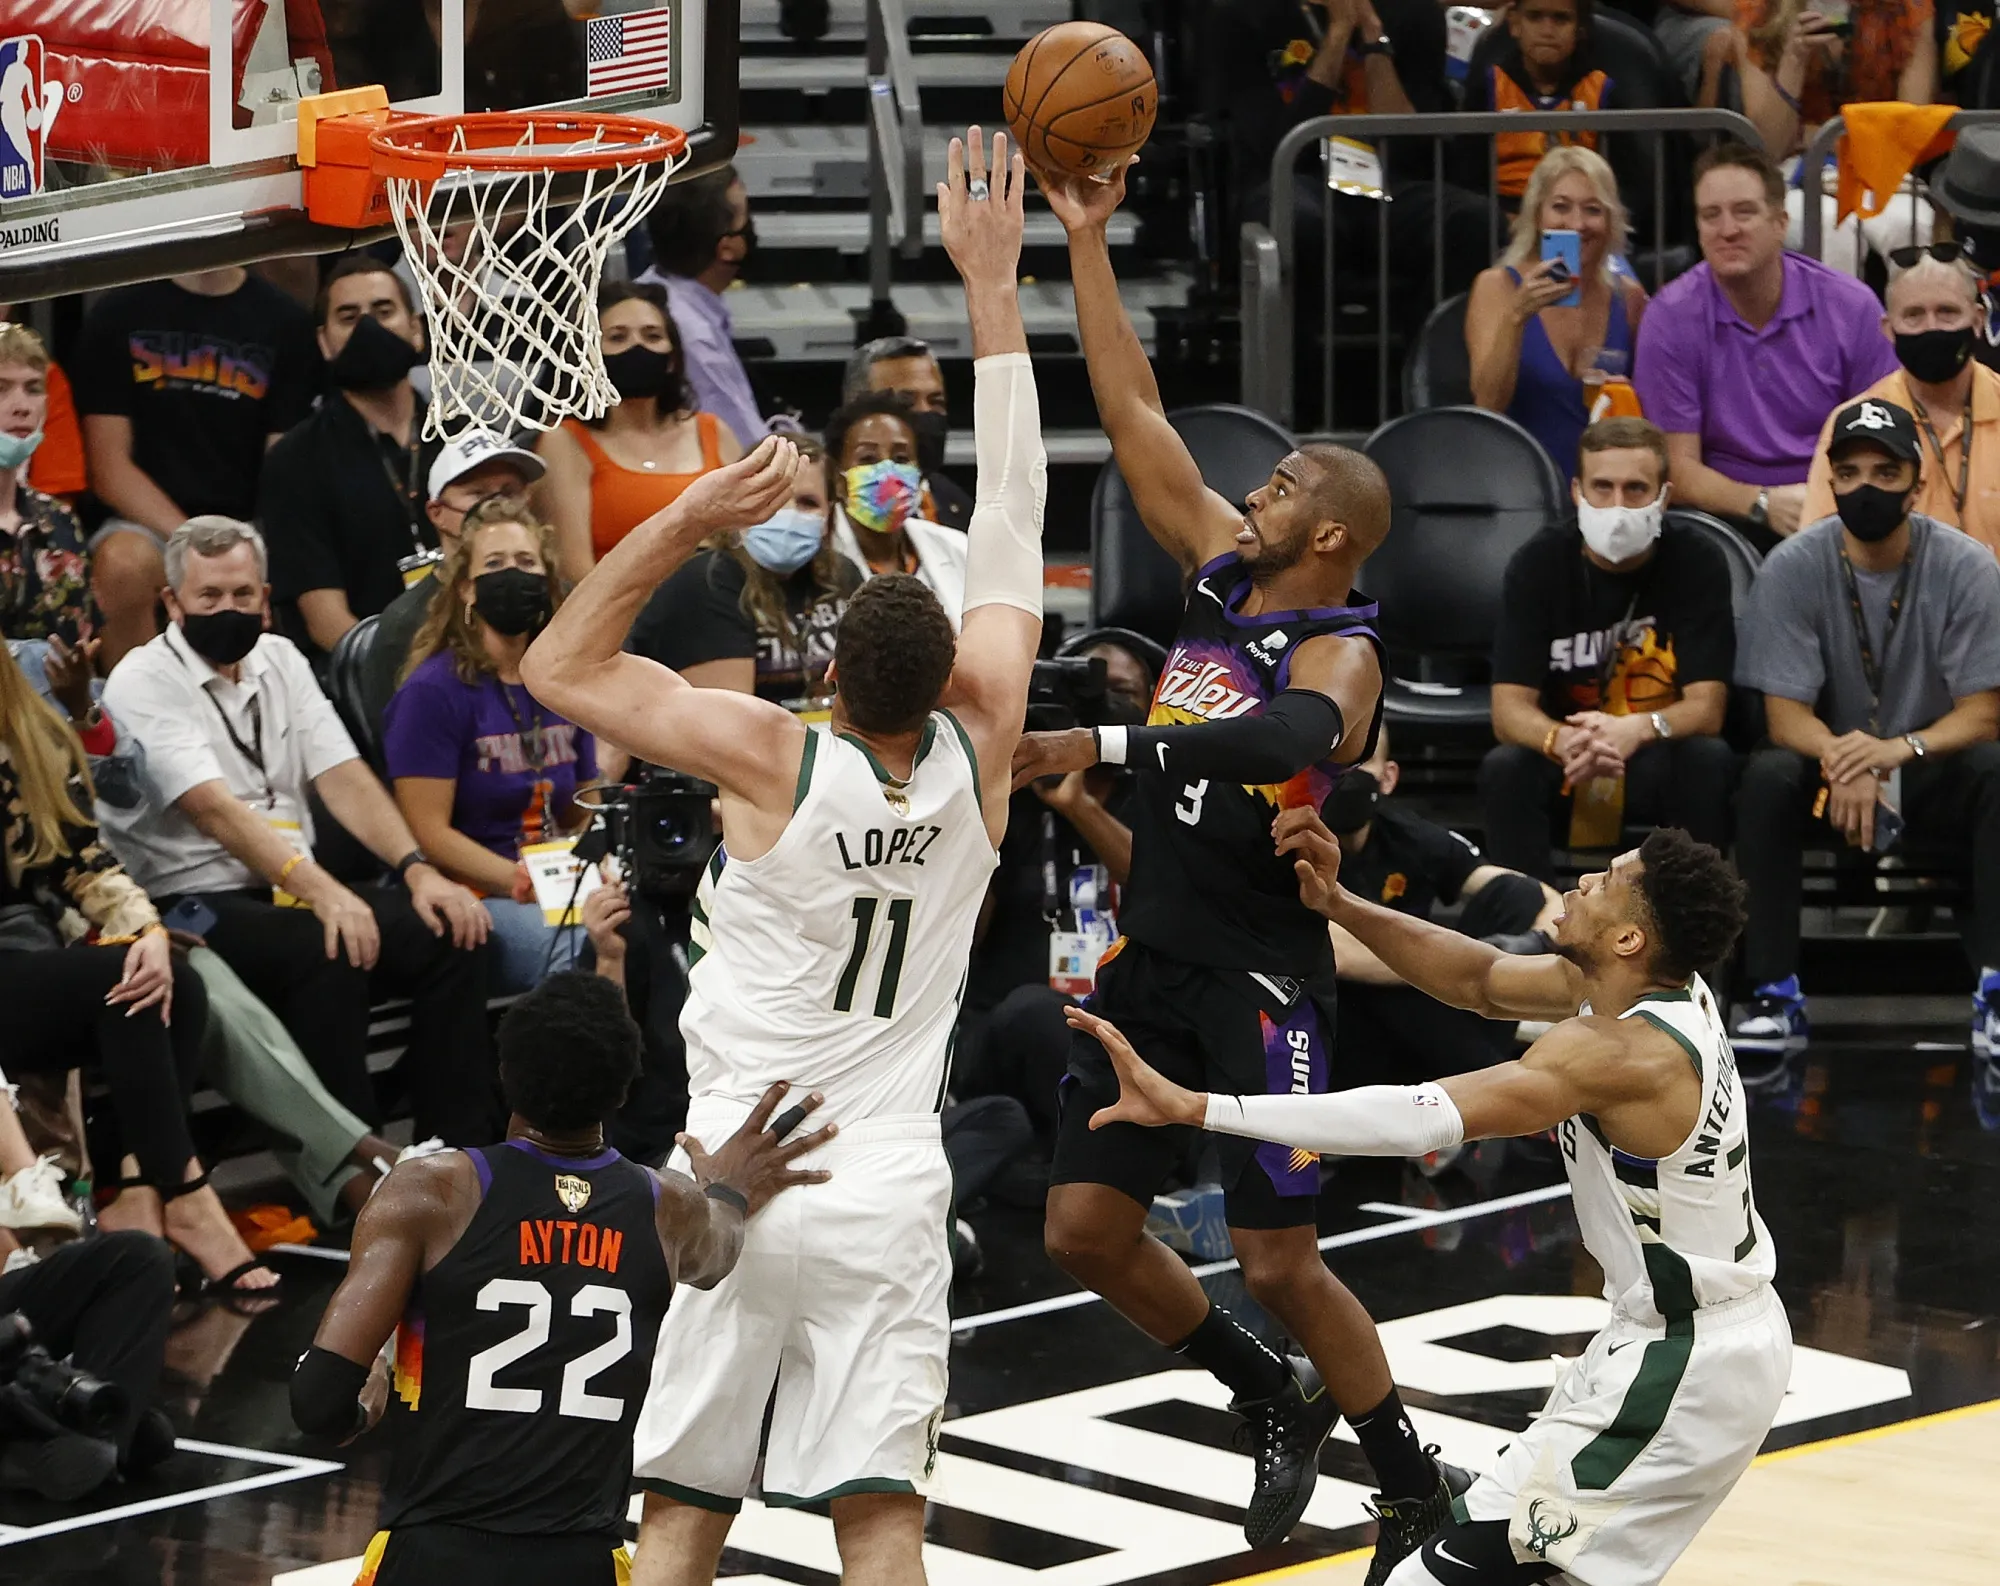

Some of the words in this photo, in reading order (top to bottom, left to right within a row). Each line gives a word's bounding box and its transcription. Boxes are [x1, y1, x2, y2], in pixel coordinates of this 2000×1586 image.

[3, 164, 26, 192] NBA
[0, 217, 60, 250] PALDING
[1177, 657, 1204, 673] THE
[1245, 640, 1277, 667] PayPal
[1174, 778, 1209, 826] 3
[835, 825, 942, 870] LOPEZ
[833, 897, 913, 1019] 11
[1286, 1029, 1311, 1095] SUN
[520, 1219, 623, 1273] AYTON
[465, 1278, 633, 1422] 22
